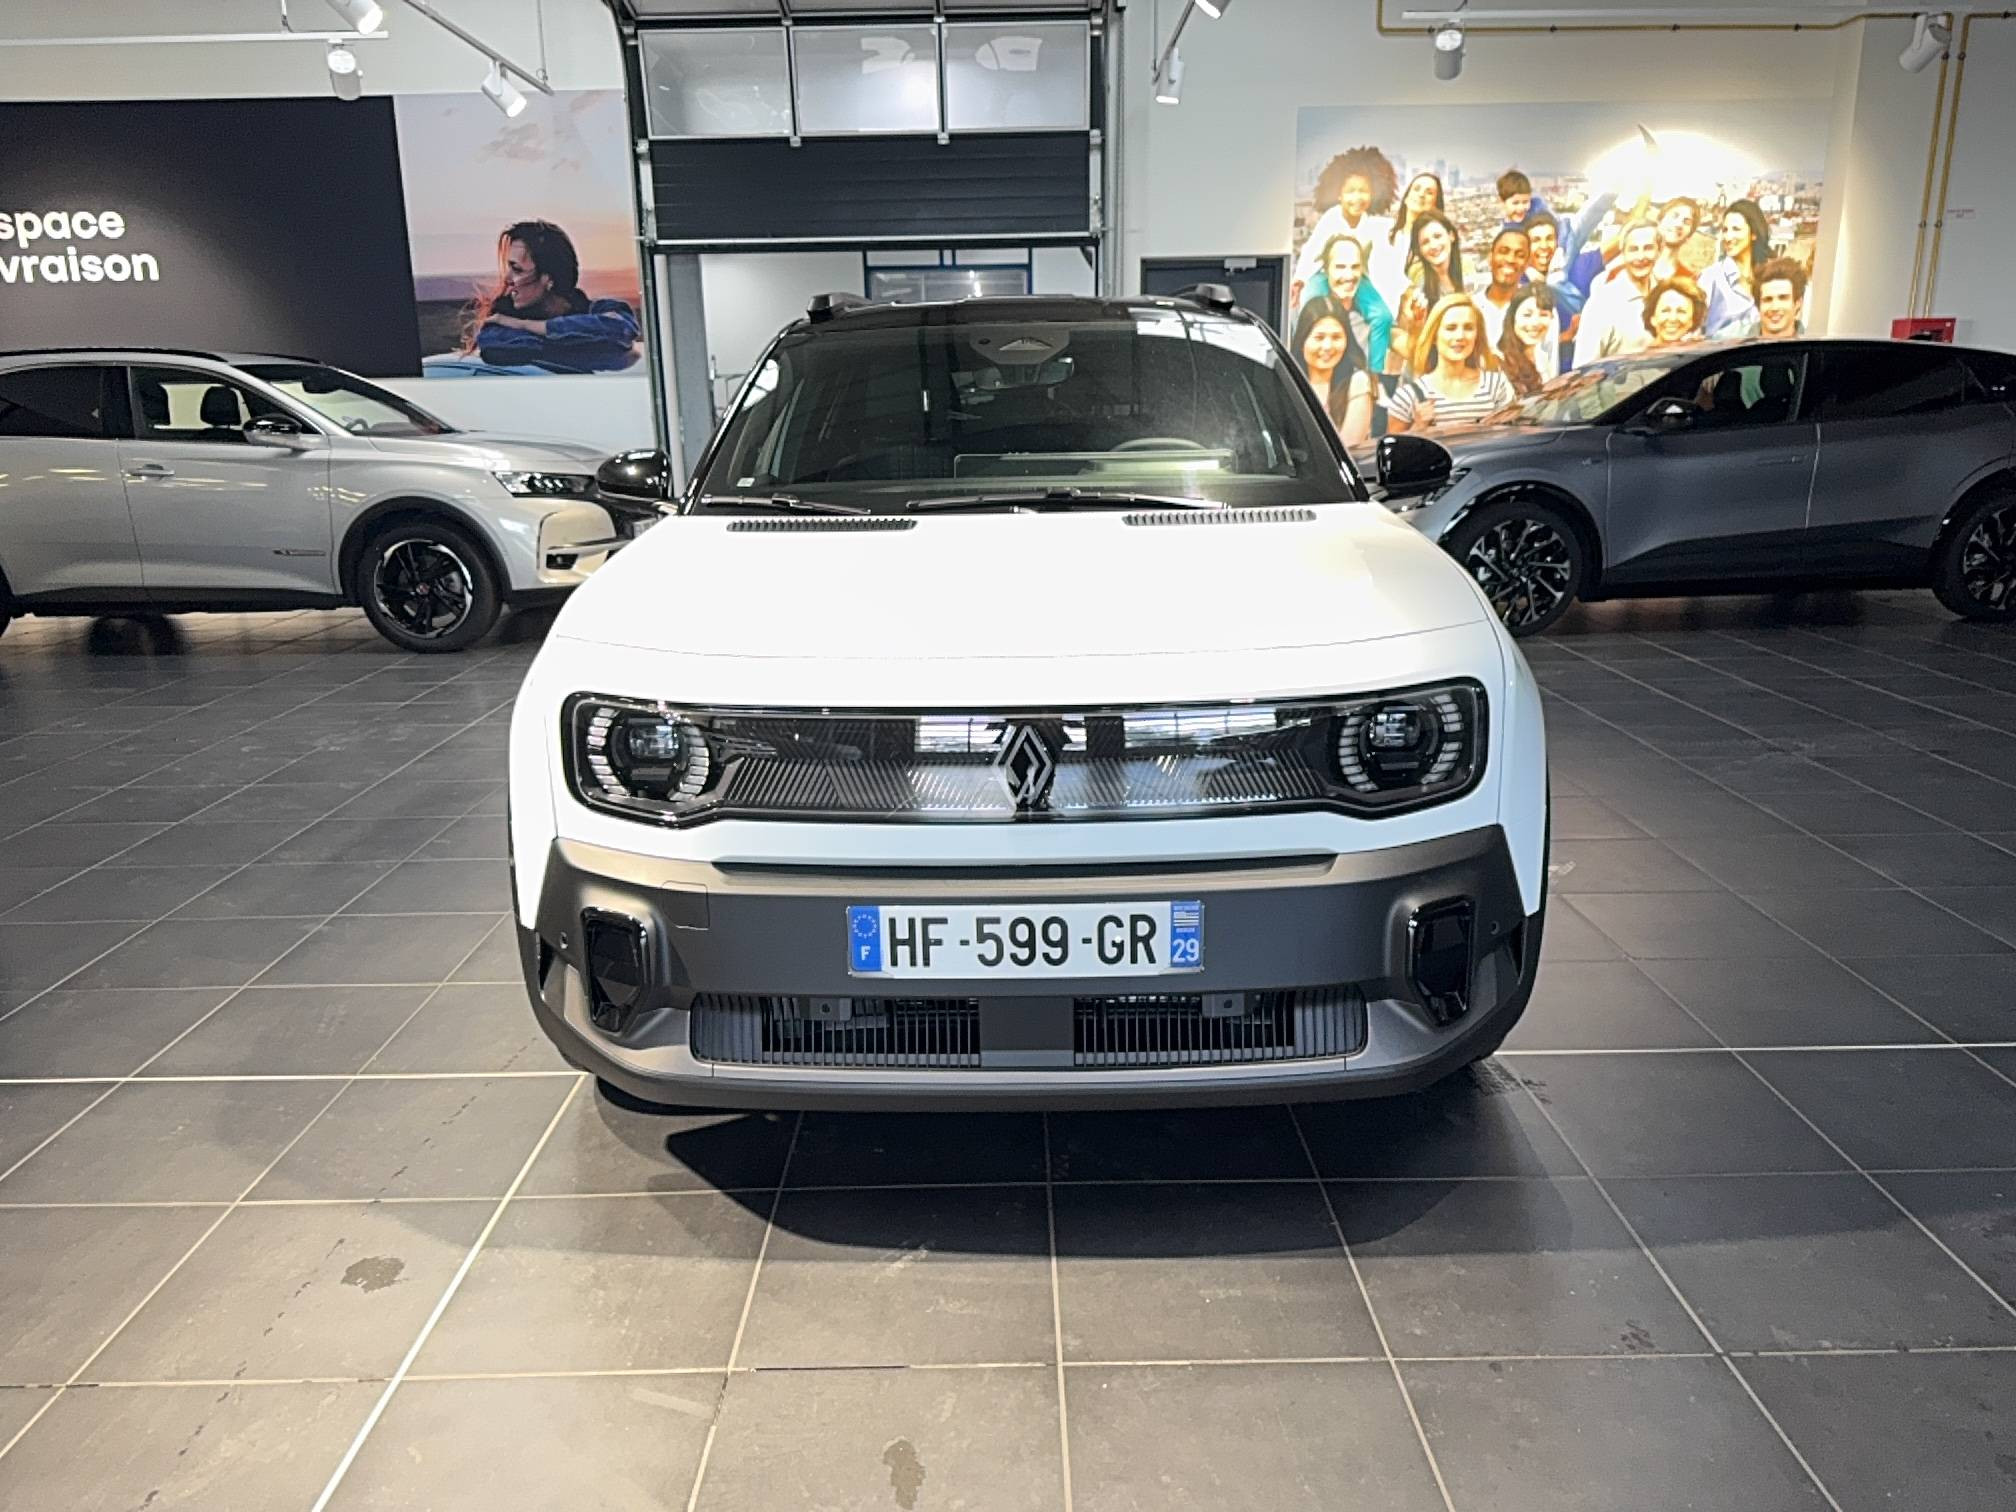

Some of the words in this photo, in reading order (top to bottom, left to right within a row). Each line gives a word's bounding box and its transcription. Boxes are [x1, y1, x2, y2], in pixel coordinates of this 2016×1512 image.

[0, 246, 160, 283] vraison
[861, 945, 871, 961] F
[888, 914, 1158, 968] HF-599-GR
[1173, 938, 1200, 962] 29
